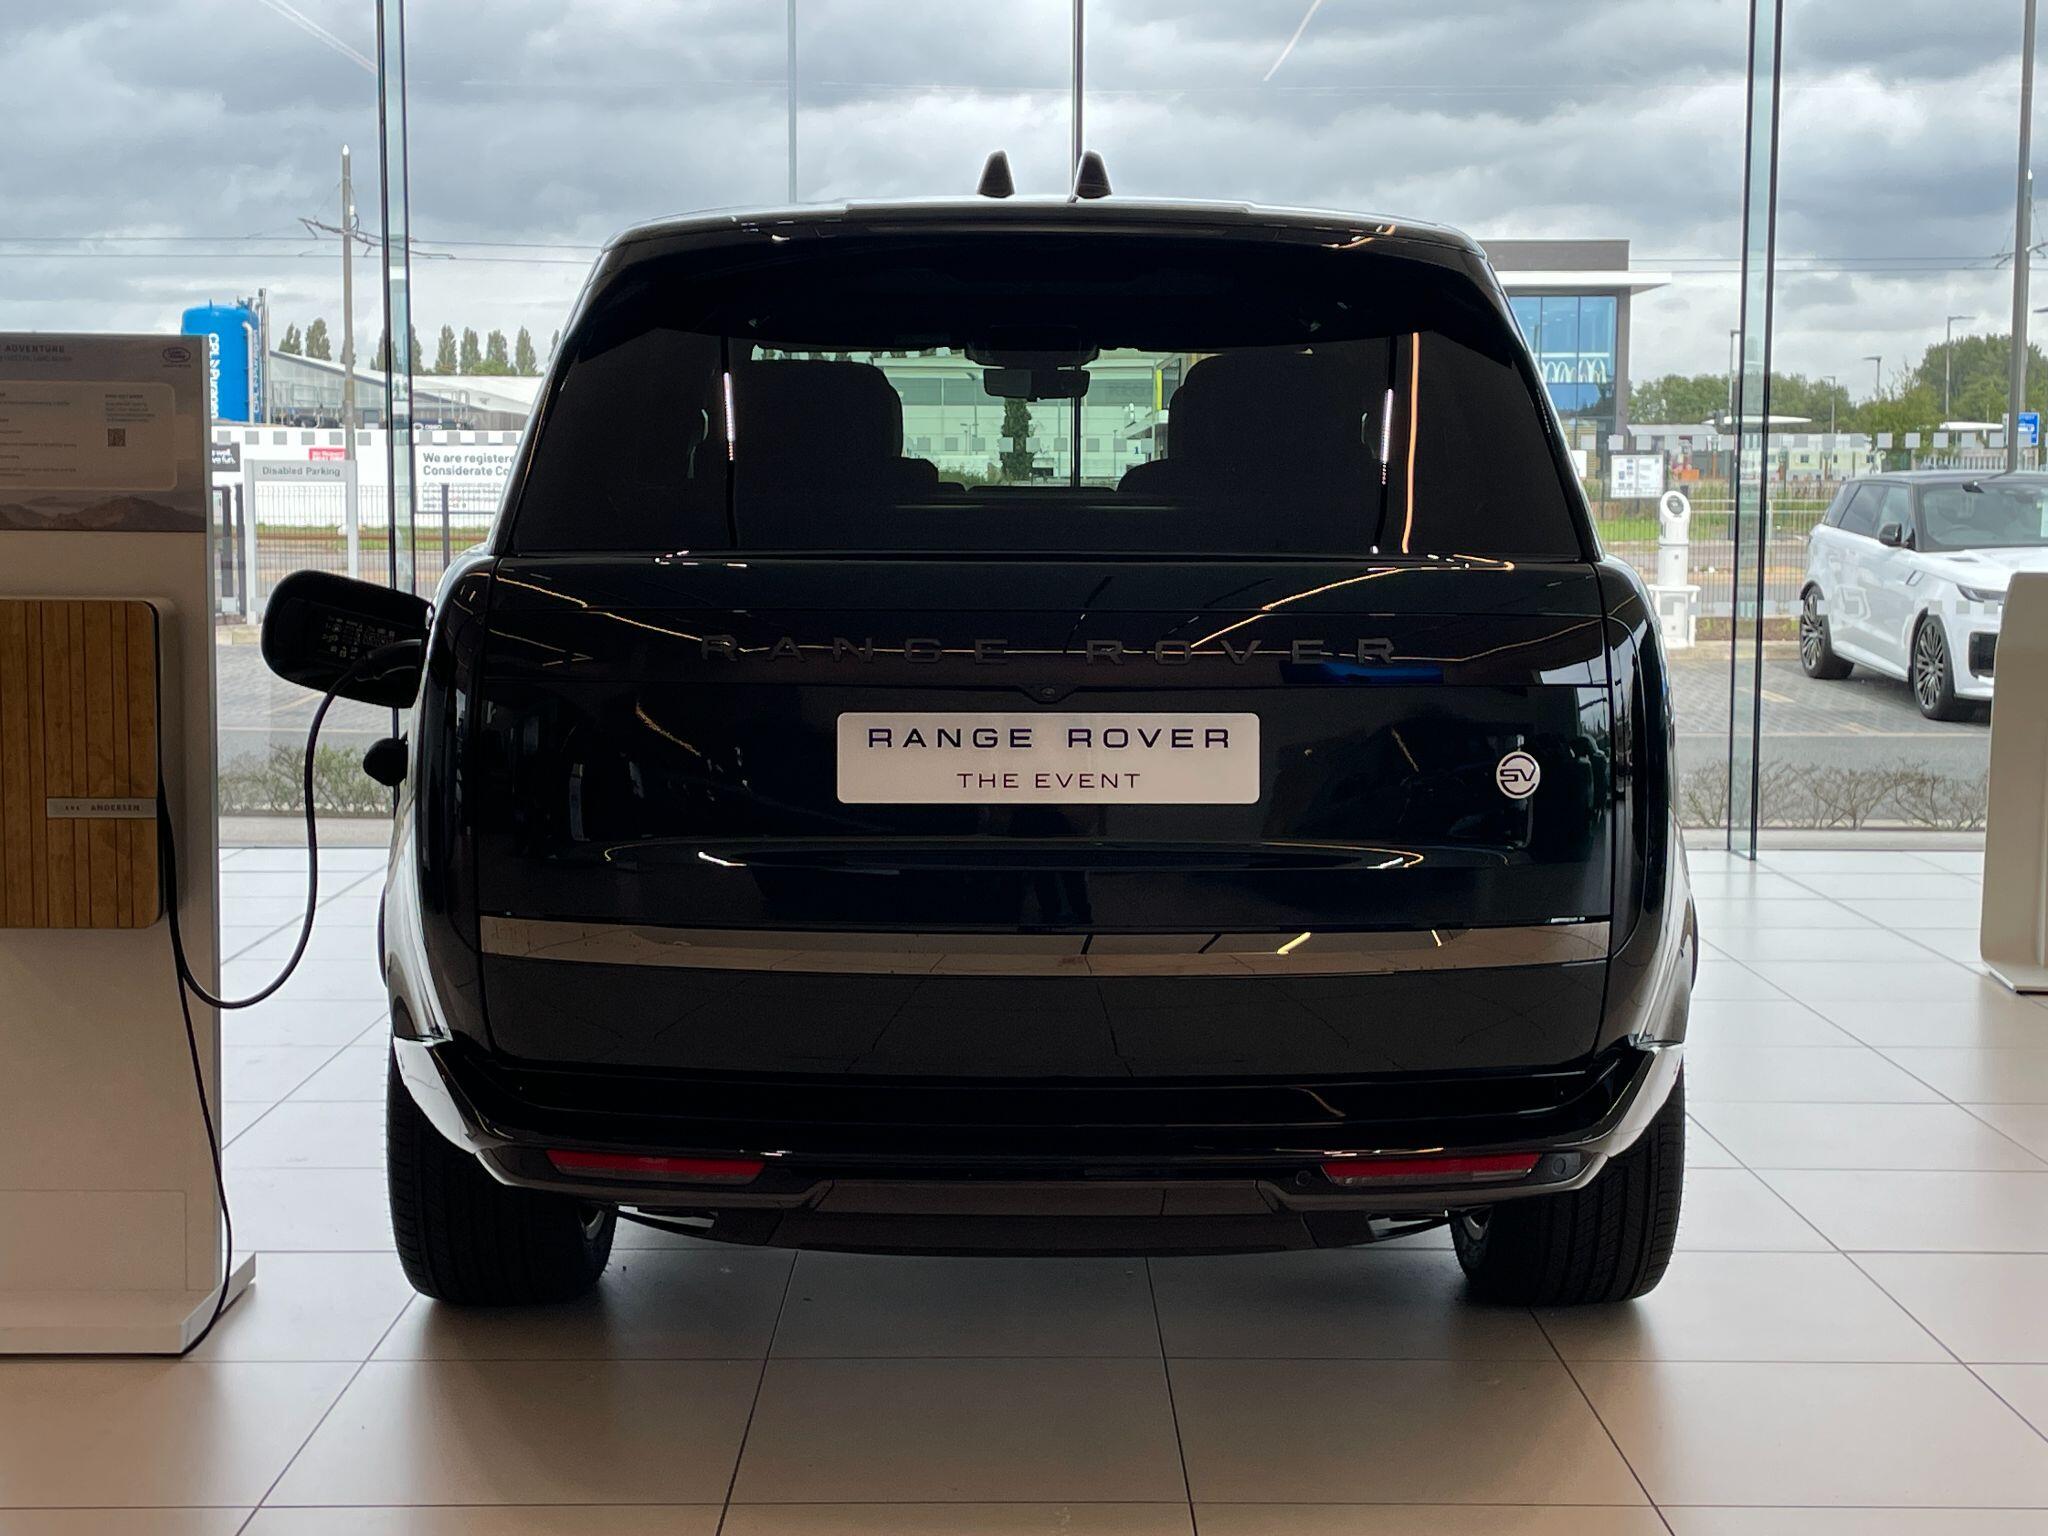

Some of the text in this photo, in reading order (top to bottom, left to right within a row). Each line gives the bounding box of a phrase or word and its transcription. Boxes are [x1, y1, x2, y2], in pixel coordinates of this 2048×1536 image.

[423, 453, 441, 462] We
[443, 454, 461, 463] are
[262, 466, 341, 477] Disabled Parking
[423, 465, 493, 476] Considerate
[701, 634, 1395, 665] RANGE ROVER
[868, 728, 1230, 749] RANGE ROVER
[957, 773, 1141, 789] THE EVENT
